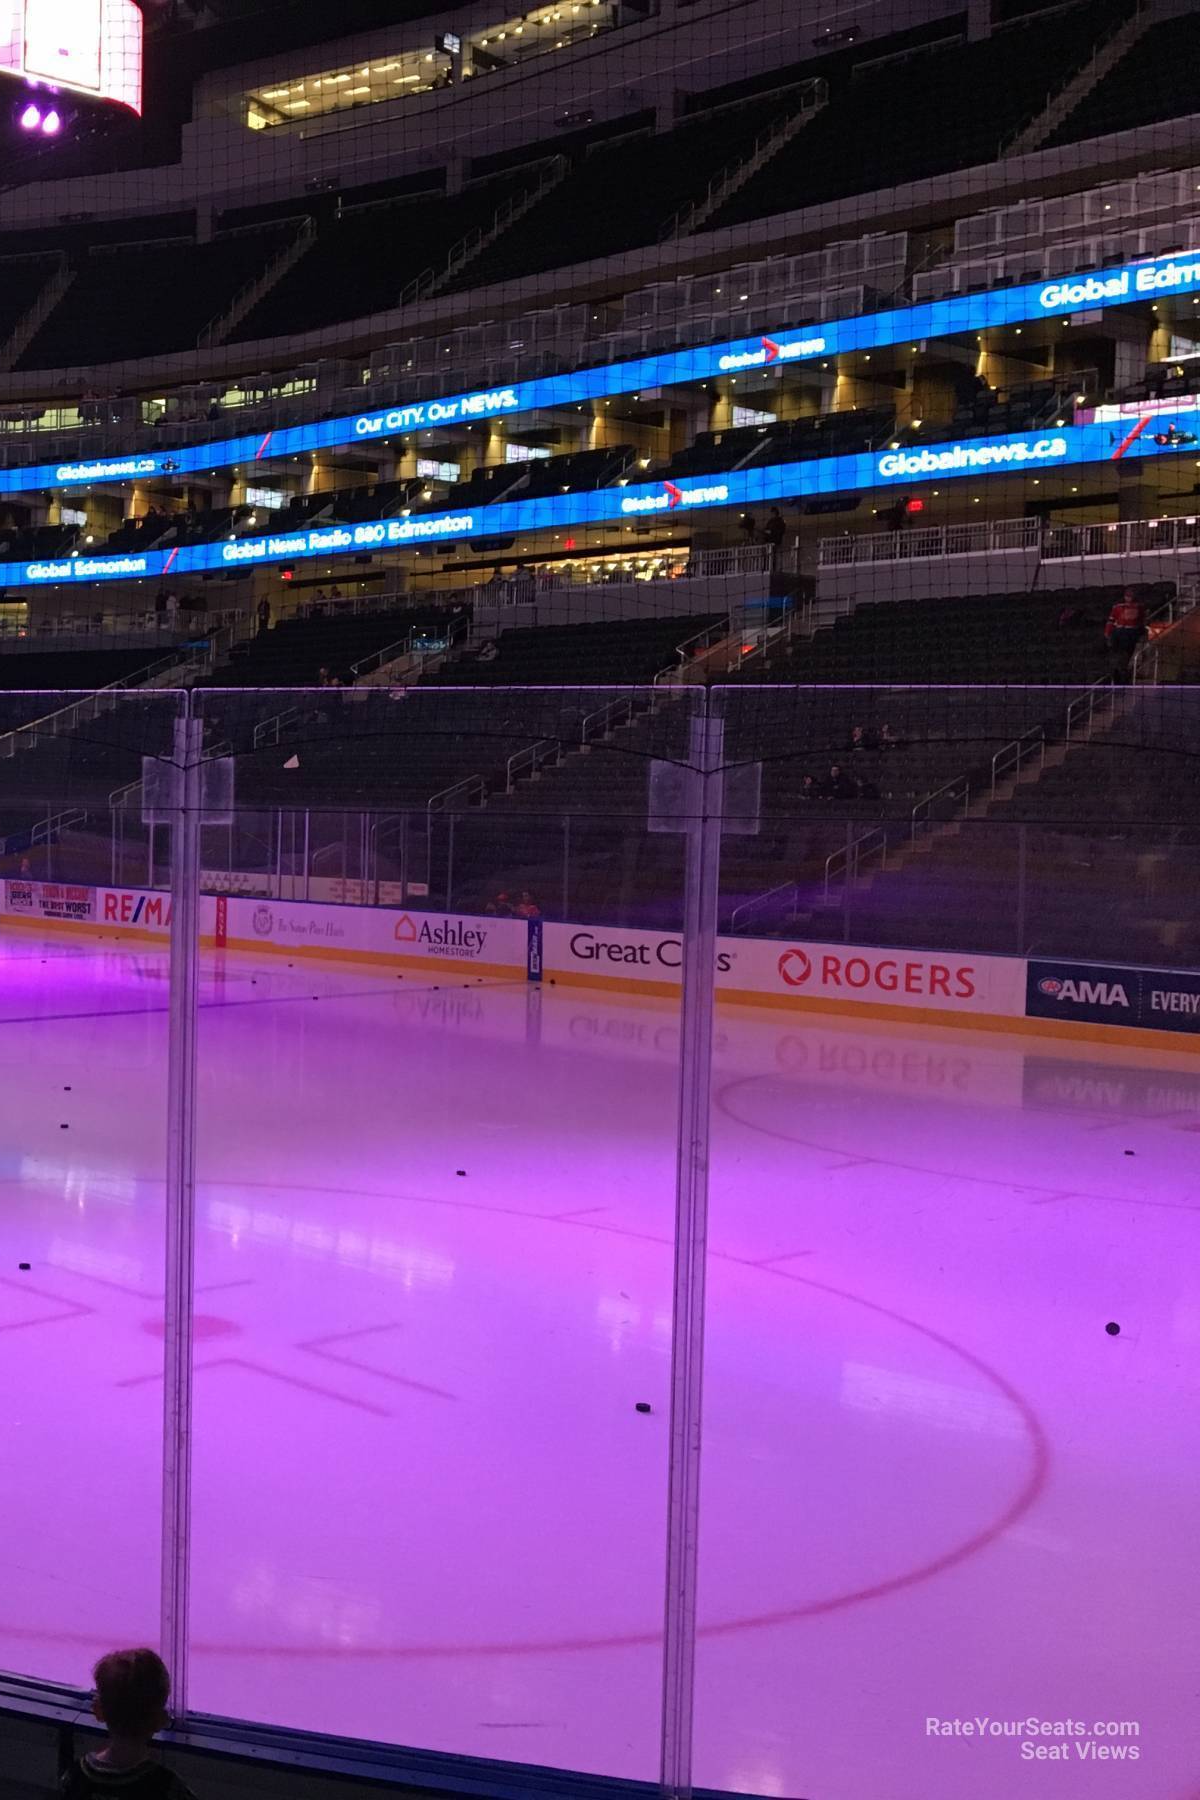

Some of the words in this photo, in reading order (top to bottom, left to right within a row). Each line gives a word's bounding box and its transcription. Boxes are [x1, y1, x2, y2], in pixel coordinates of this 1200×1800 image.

[1040, 275, 1129, 309] Global
[719, 352, 767, 370] Global
[778, 337, 826, 358] NEWS
[356, 416, 384, 435] Our
[428, 402, 457, 421] Our
[56, 458, 156, 482] Globalnews.ca
[878, 437, 1067, 478] Globalnews.ca
[622, 494, 668, 513] Global
[682, 484, 729, 506] NEWS
[222, 539, 267, 561] Global
[268, 534, 307, 556] News
[308, 529, 352, 552] Radio
[388, 513, 473, 541] Edmonton
[26, 561, 72, 580] Global
[74, 556, 146, 576] Edmonton
[65, 901, 92, 914] WORST
[105, 893, 171, 926] RE/M
[418, 920, 487, 953] Ashley
[428, 946, 475, 958] HOMESTORE
[571, 932, 650, 965] Great
[821, 955, 976, 998] ROGERS
[1057, 979, 1129, 1007] AMA
[1151, 990, 1200, 1014] EVERY
